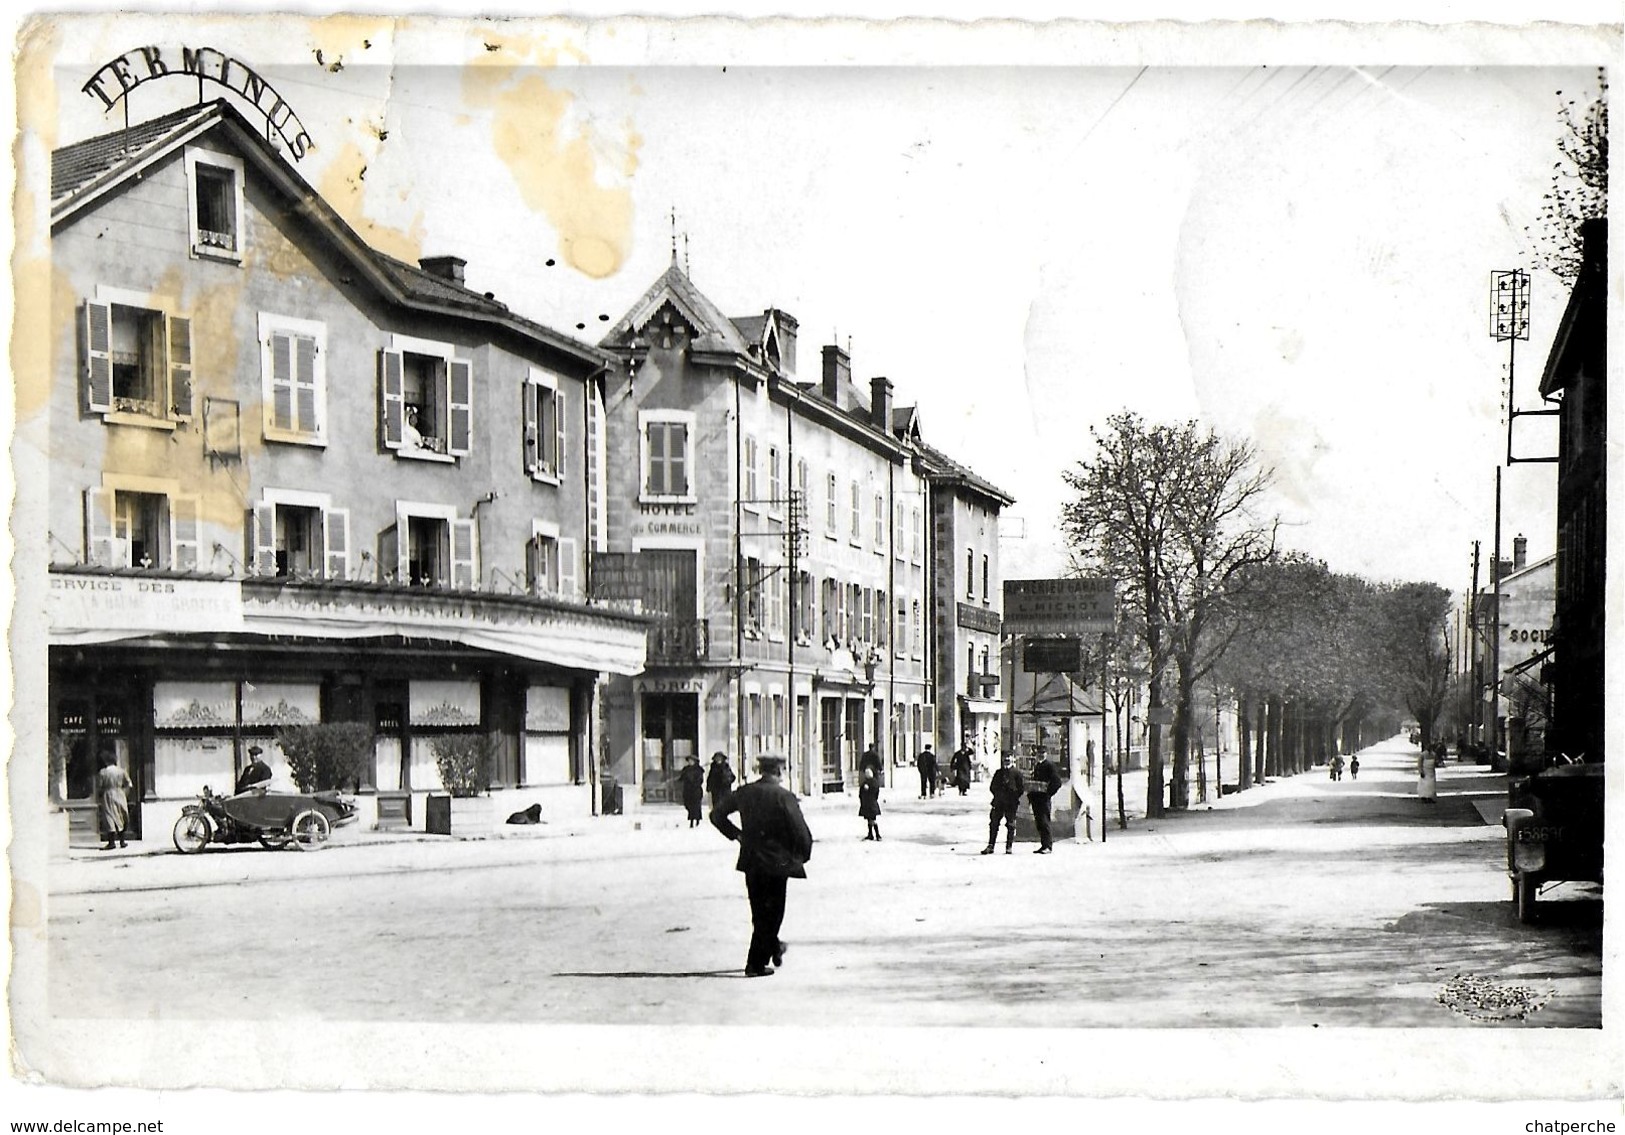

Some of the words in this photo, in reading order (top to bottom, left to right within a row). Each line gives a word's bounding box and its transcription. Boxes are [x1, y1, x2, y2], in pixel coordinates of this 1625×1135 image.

[81, 44, 315, 162] TERMINUS
[641, 503, 695, 516] HOTEL
[648, 521, 702, 534] COMMERCE
[138, 582, 176, 593] DES
